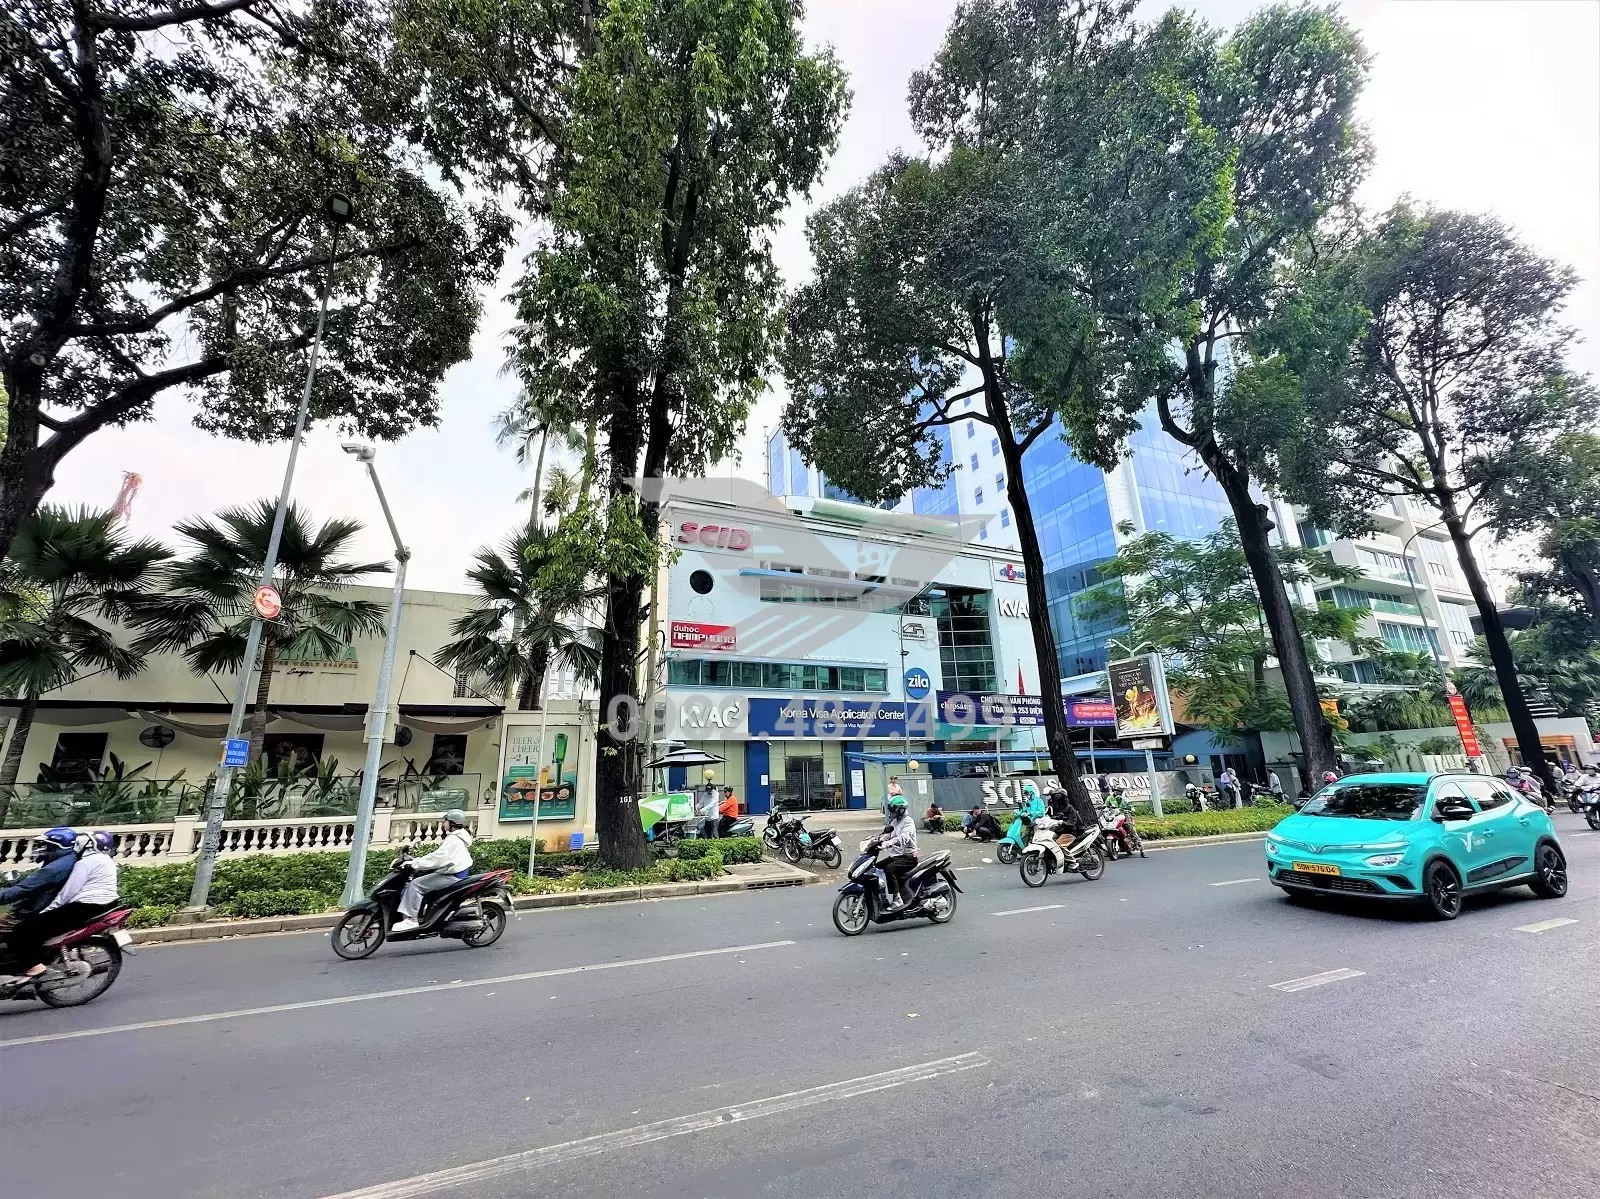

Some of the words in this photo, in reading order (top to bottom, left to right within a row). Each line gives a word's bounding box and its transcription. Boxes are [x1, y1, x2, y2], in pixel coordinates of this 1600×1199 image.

[678, 522, 751, 550] SCID
[998, 598, 1030, 619] KVA
[673, 625, 699, 633] duhoc
[907, 674, 929, 688] zila
[980, 696, 993, 704] CHO
[681, 701, 741, 728] KVAC
[780, 706, 808, 719] Korea
[809, 708, 832, 719] Visa
[832, 708, 876, 721] Application
[878, 709, 905, 720] Center
[1018, 707, 1029, 715] 253
[980, 778, 1040, 807] SCID
